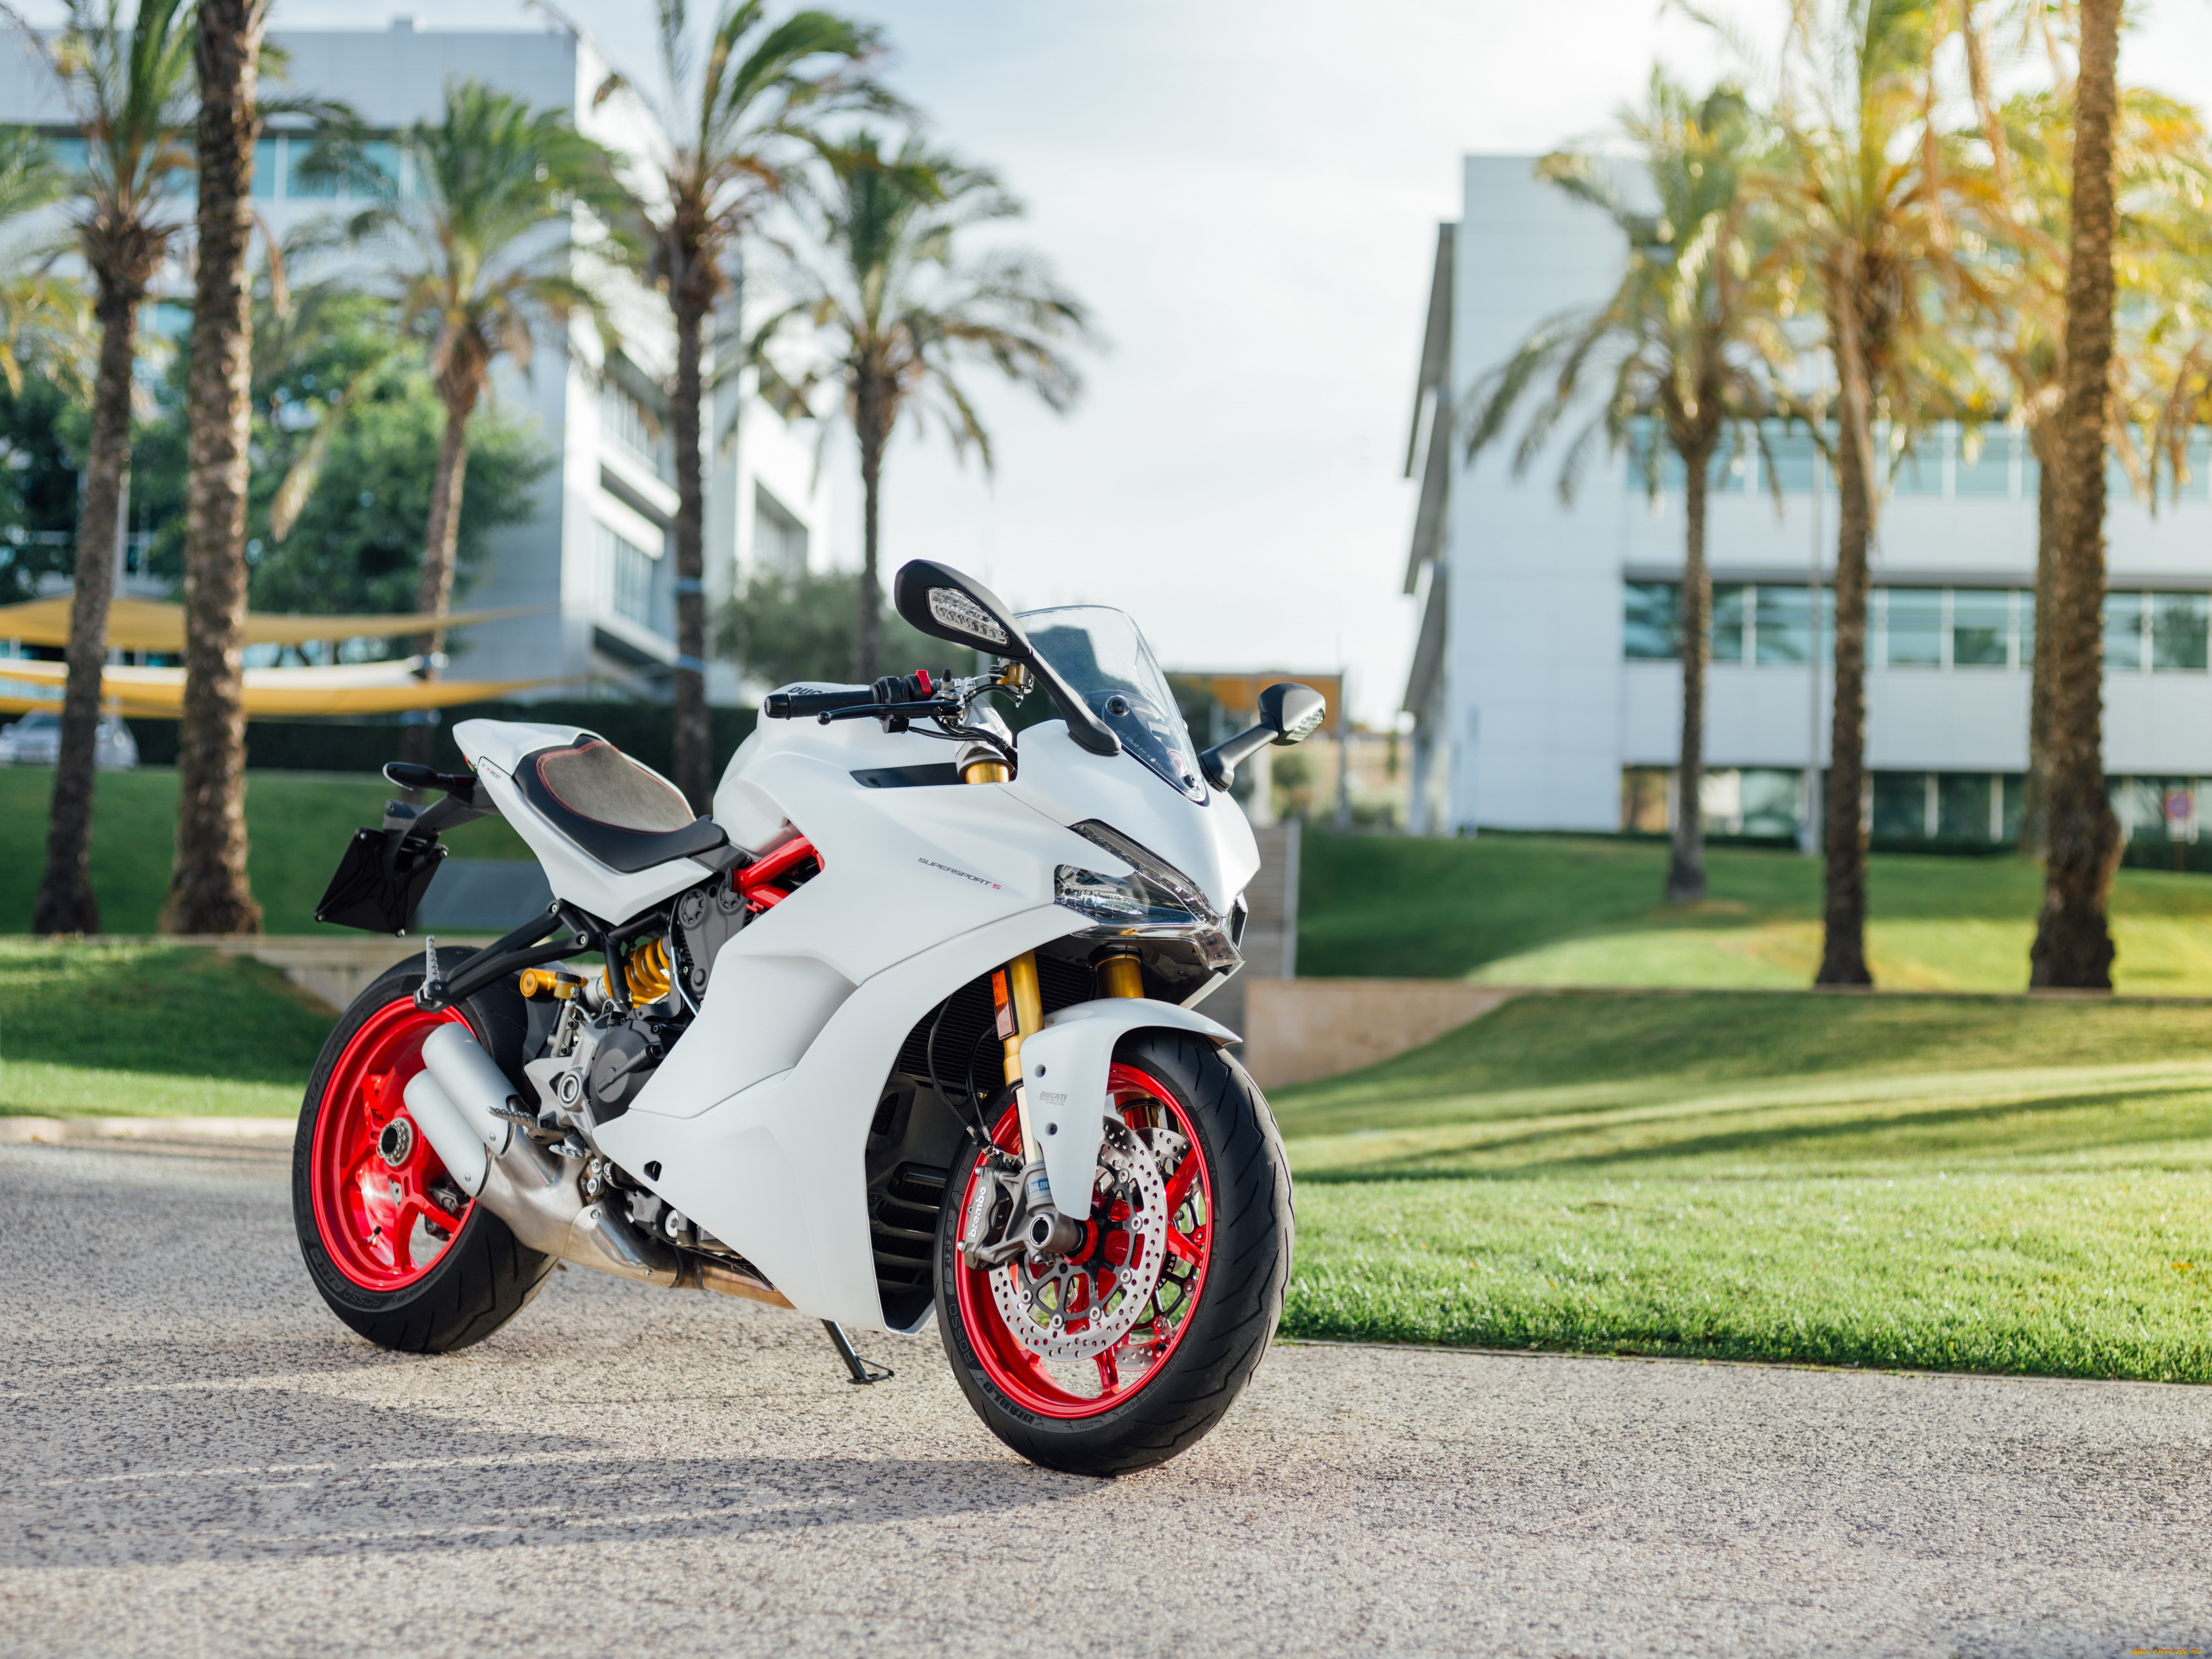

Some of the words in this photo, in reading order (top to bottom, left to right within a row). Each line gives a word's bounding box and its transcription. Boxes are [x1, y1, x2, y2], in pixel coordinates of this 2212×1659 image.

[918, 858, 992, 885] SUPERSPORT
[1040, 1091, 1068, 1101] DUCATI
[968, 1186, 987, 1238] brembo
[343, 1291, 382, 1306] ROSSO
[949, 1304, 974, 1364] ROSSO
[983, 1381, 1035, 1425] DIABLO
